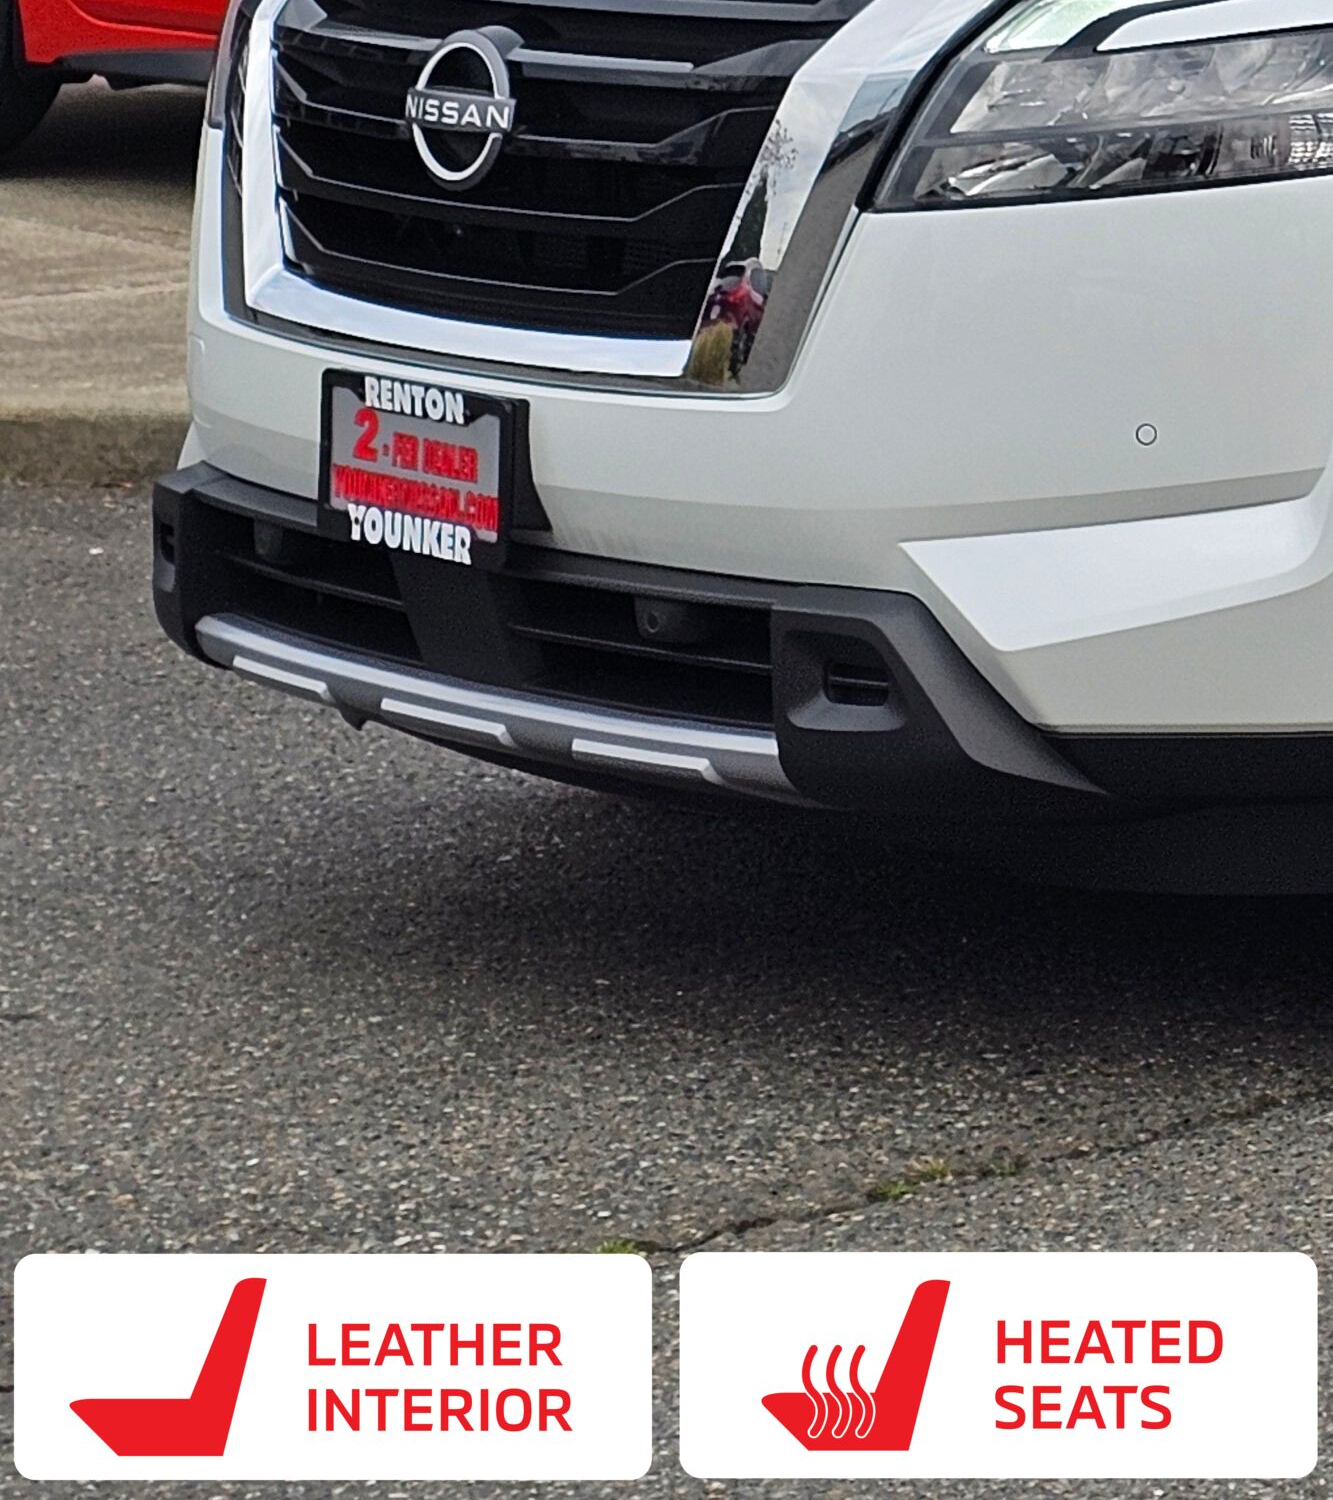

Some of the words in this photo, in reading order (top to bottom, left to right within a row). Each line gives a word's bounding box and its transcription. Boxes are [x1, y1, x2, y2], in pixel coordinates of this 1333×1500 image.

[405, 94, 509, 129] NISSAN
[363, 375, 465, 425] RENTON
[353, 407, 379, 462] 2
[347, 503, 472, 565] YOUNKER
